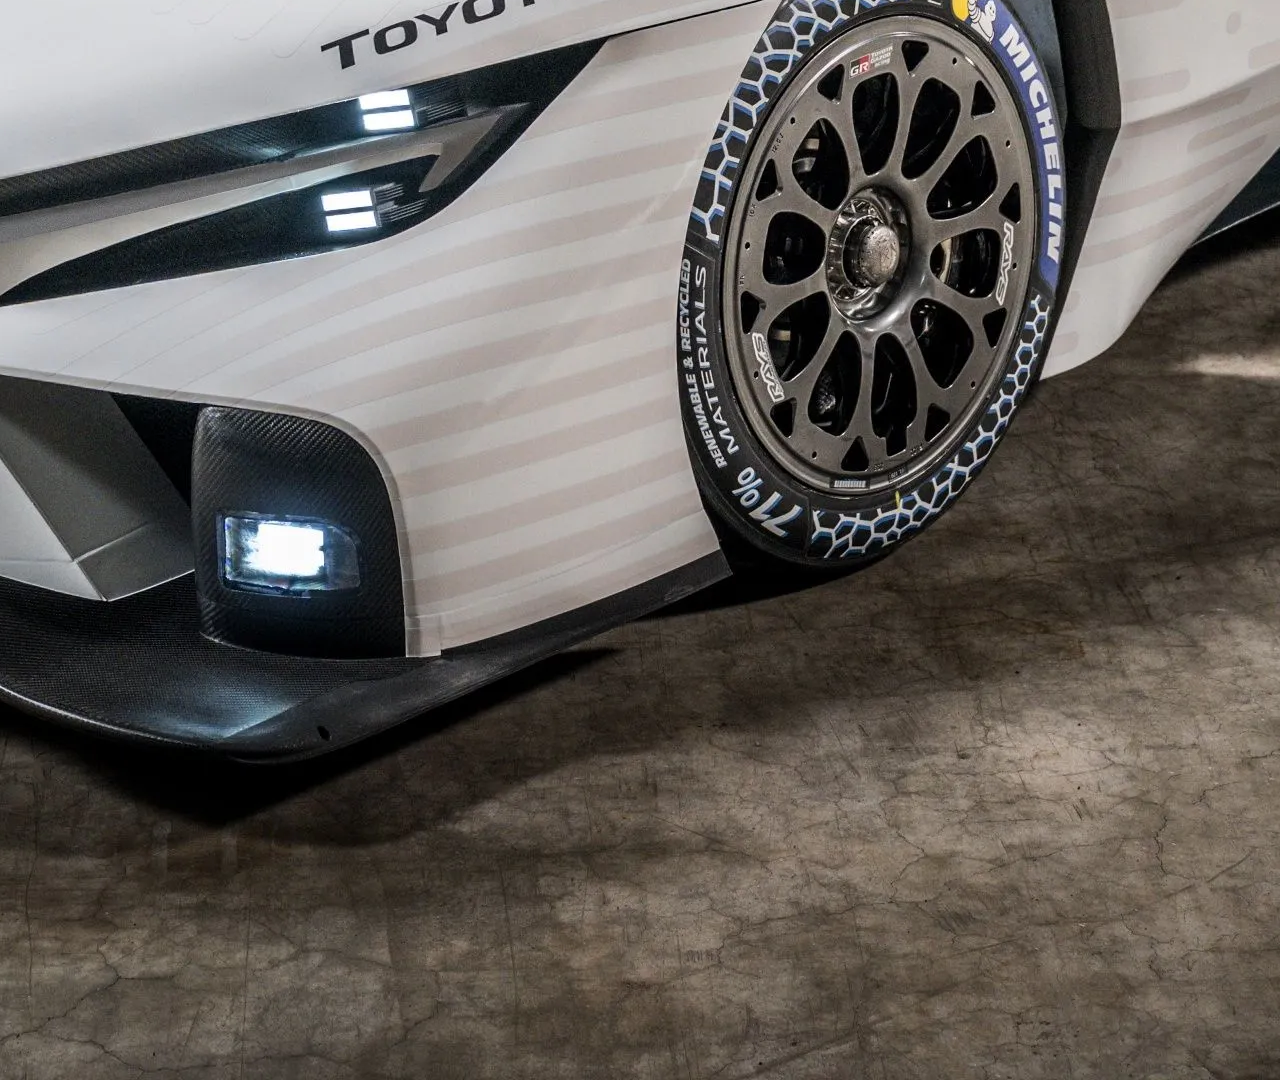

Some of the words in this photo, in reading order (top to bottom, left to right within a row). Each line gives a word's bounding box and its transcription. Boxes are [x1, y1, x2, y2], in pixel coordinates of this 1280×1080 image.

[850, 61, 869, 77] GR
[999, 24, 1062, 263] MICHELIN
[679, 258, 692, 352] RECYCLED
[683, 356, 694, 369] &
[695, 264, 740, 454] MATERIALS
[685, 373, 728, 468] RENEWABLE
[731, 466, 804, 537] 71%
